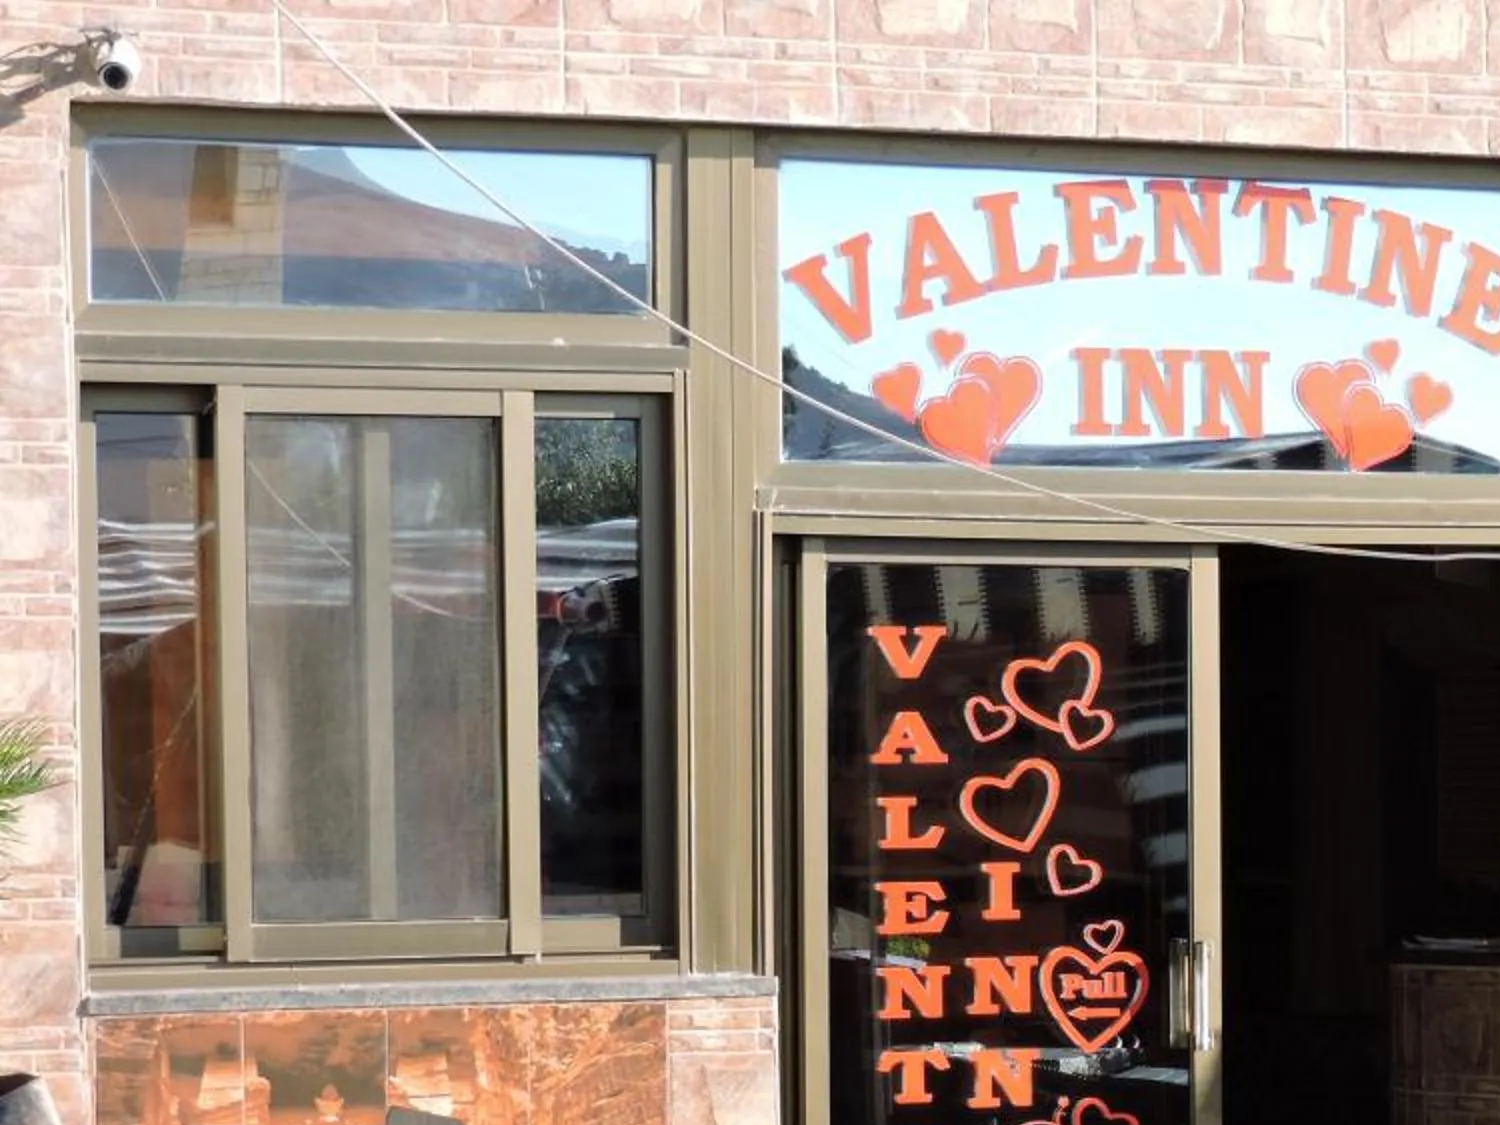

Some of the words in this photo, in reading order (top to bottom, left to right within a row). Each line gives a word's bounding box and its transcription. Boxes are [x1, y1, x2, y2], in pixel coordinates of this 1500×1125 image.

[1070, 346, 1271, 440] INN
[964, 860, 1040, 1112] INN
[1058, 971, 1128, 1000] Pull
